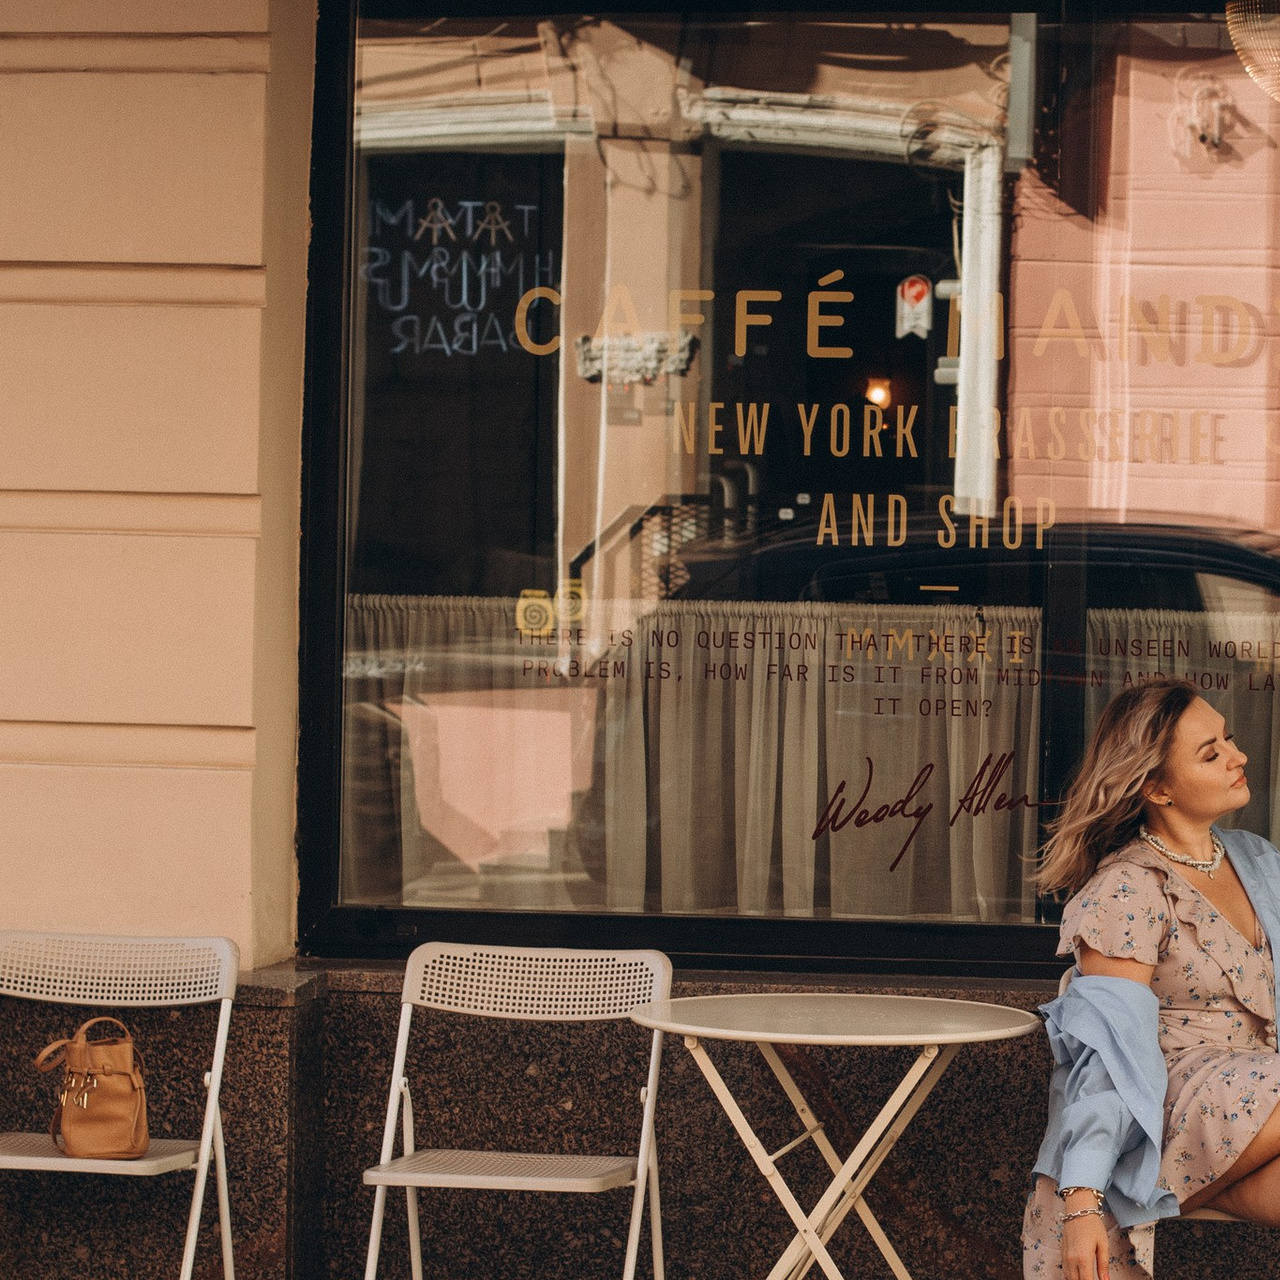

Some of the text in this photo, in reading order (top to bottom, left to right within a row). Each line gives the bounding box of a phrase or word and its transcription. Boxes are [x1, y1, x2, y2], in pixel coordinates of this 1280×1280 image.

[515, 269, 855, 359] CAFFÉ
[673, 402, 770, 456] NEW
[797, 404, 919, 458] YORK
[816, 492, 1057, 550] AND SHOP
[514, 627, 587, 646] THERE
[607, 628, 633, 647] IS
[651, 630, 680, 649] NO
[697, 630, 818, 651] QUESTION
[835, 633, 894, 652] THAT
[912, 634, 987, 655] THERE
[1006, 636, 1034, 655] IS
[1099, 638, 1191, 658] UNSEEN
[522, 659, 626, 678] PROBLEM
[644, 661, 684, 683] IS,
[704, 662, 748, 681] HOW
[767, 663, 809, 682] FAR
[828, 664, 856, 683] IS
[873, 666, 901, 684] IT
[920, 666, 979, 686] FROM
[873, 697, 993, 719] IT OPEN?
[812, 750, 1055, 872] Woody Allen
